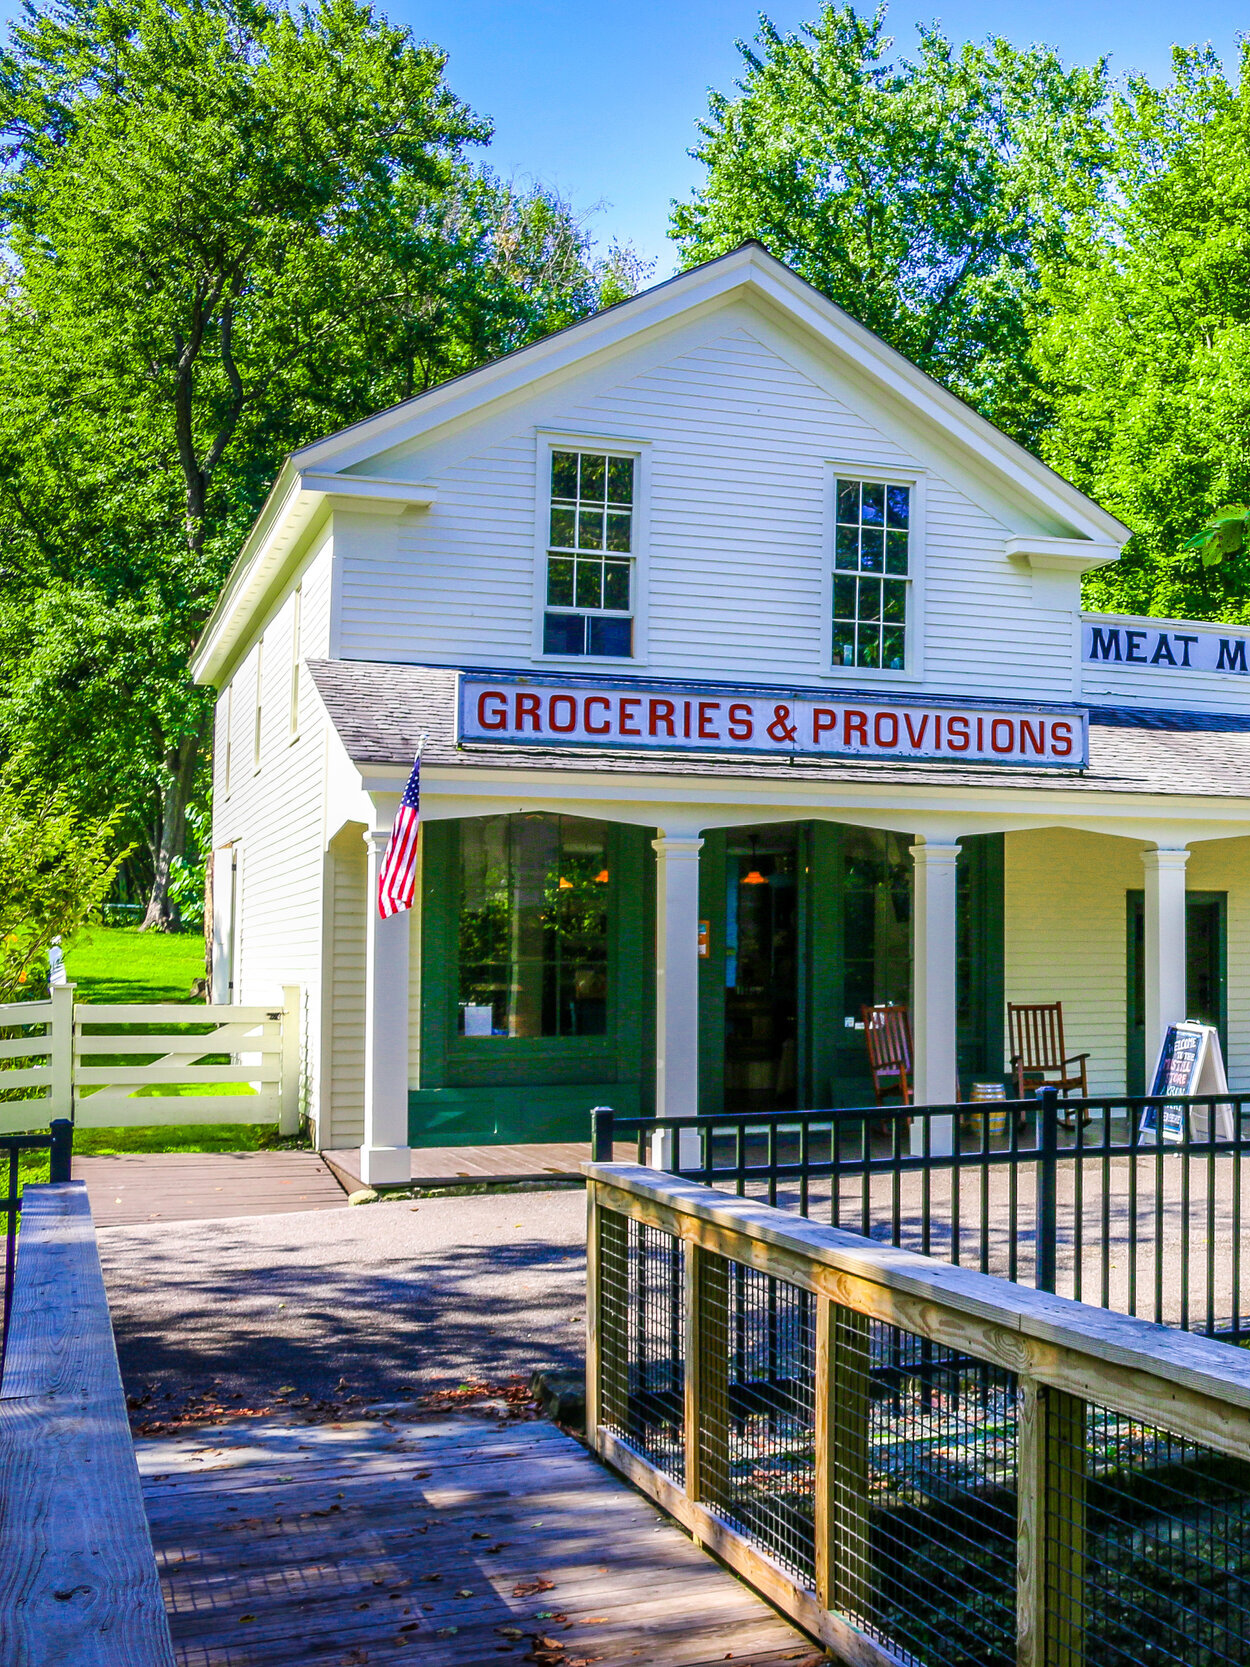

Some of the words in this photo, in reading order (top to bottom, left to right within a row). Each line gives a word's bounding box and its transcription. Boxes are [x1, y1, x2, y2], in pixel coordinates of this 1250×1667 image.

[1089, 627, 1199, 668] MEAT
[477, 691, 753, 740] GROCERIES
[766, 704, 798, 743] &
[813, 708, 1074, 757] PROVISIONS
